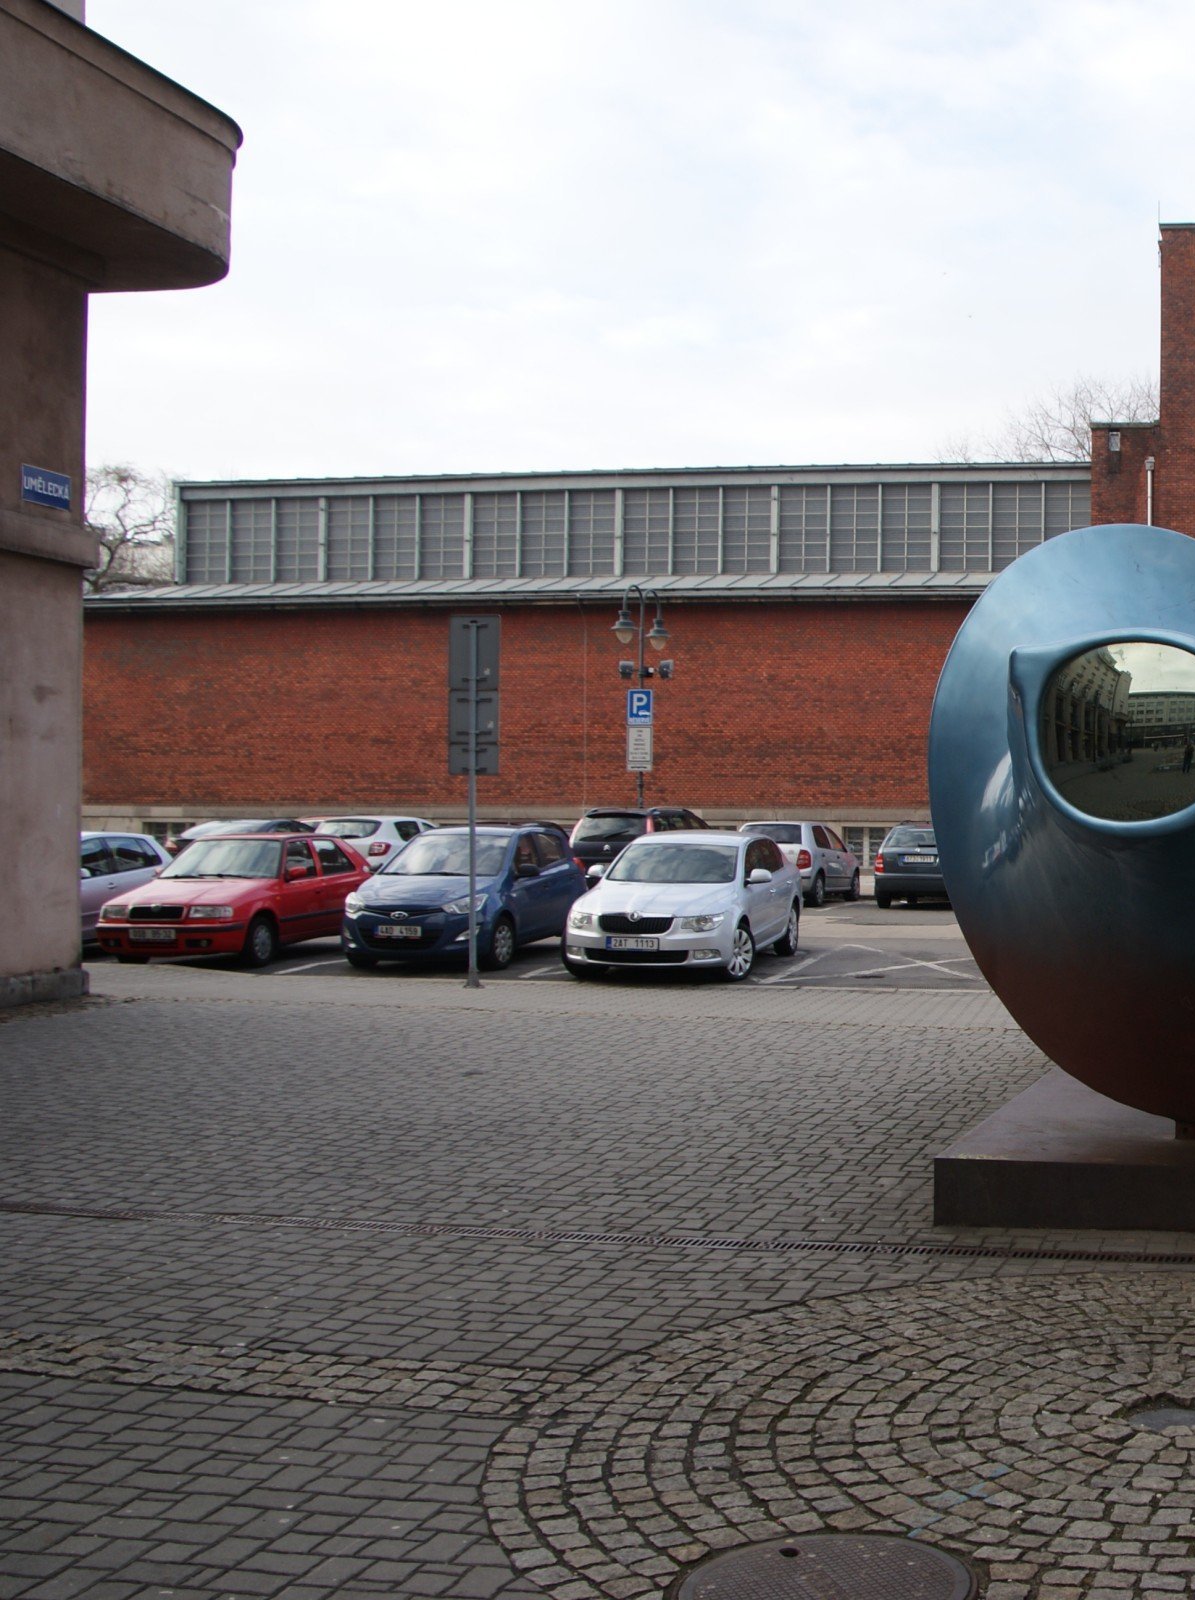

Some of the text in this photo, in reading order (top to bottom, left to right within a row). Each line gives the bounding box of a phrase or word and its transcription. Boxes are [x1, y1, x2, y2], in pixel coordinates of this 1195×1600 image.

[24, 476, 70, 500] UMĚLECKÁ
[633, 693, 648, 714] P
[613, 938, 654, 948] 2AT 1113
